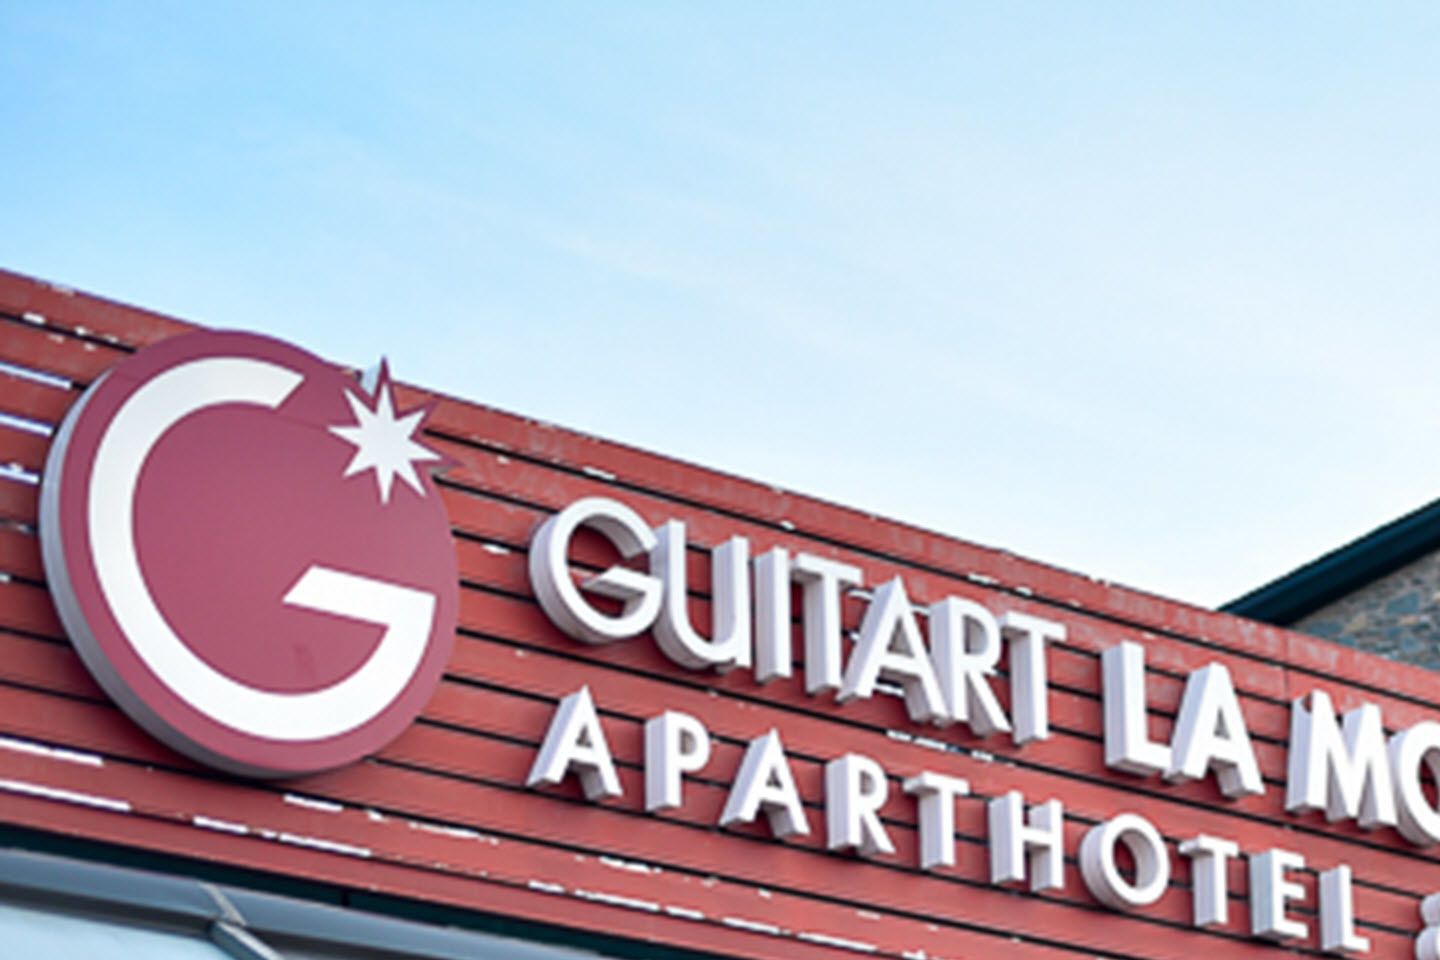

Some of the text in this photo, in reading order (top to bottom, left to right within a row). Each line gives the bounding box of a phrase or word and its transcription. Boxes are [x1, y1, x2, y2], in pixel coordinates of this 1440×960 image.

[529, 497, 1067, 747] GUITART
[1102, 640, 1265, 798] LA
[526, 685, 1370, 956] APARTHOTEL
